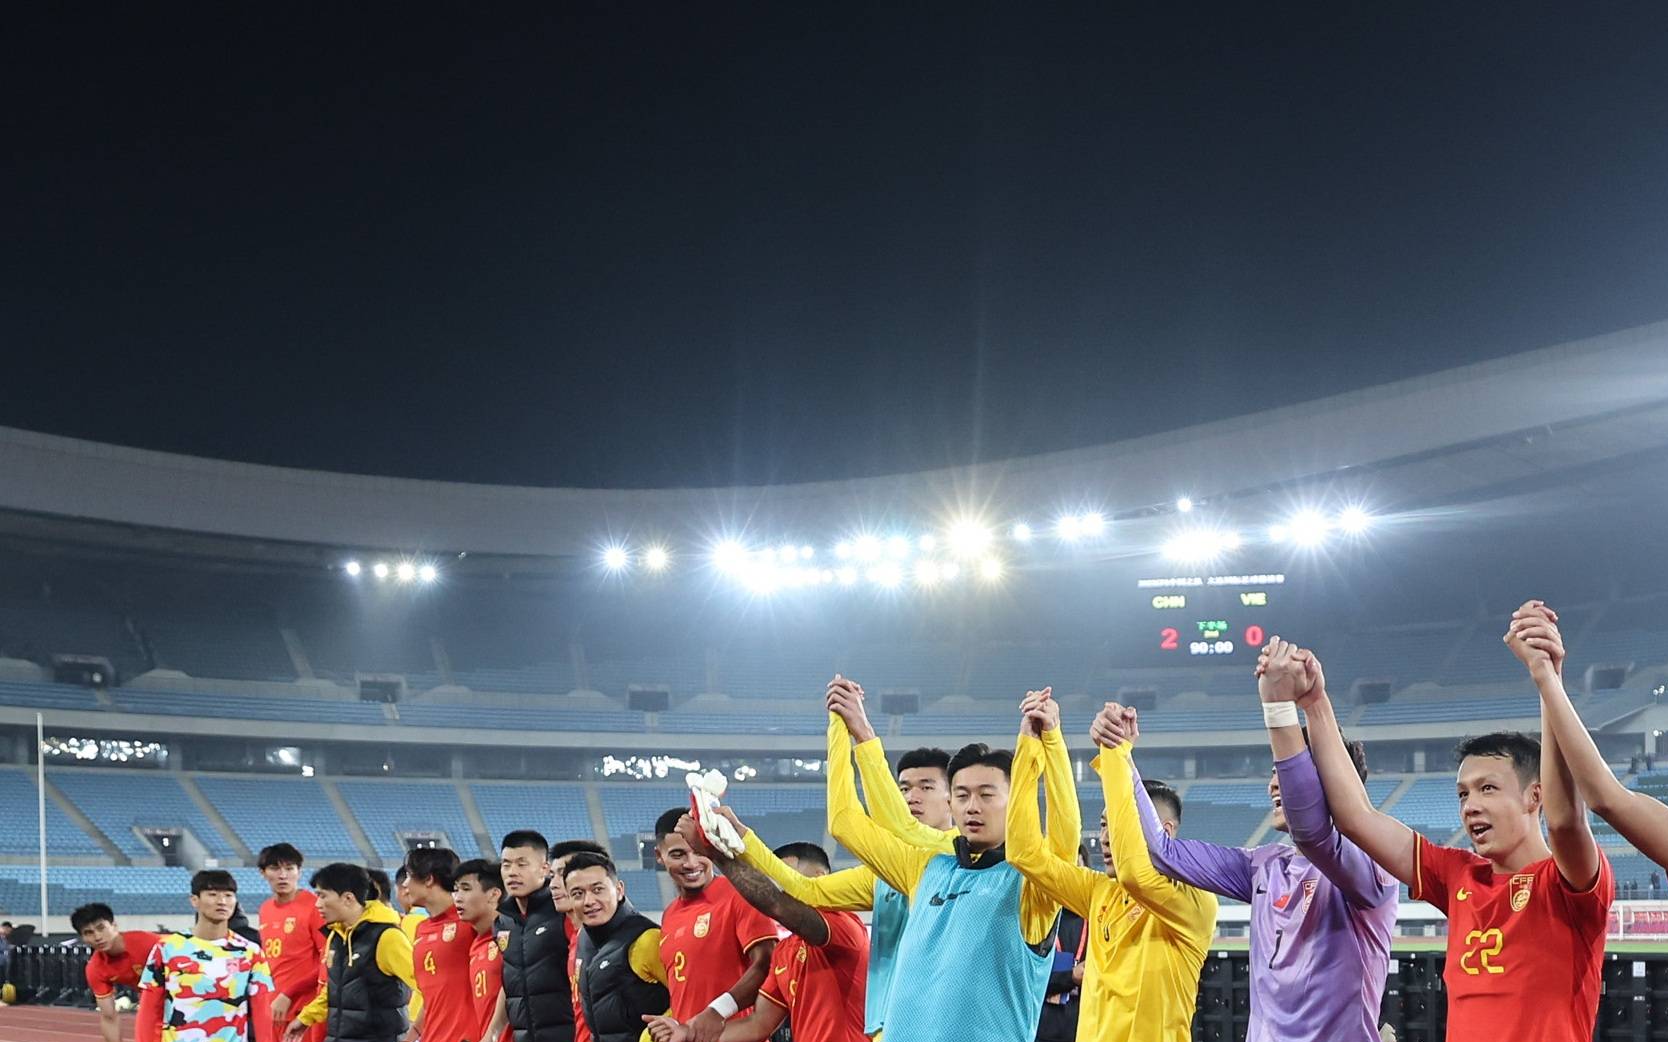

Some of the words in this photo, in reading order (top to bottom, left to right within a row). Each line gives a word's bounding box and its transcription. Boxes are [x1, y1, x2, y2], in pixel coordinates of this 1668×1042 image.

[1240, 592, 1267, 606] VIE
[1160, 628, 1179, 650] 2
[1245, 625, 1264, 647] 0
[264, 937, 282, 959] 28
[1459, 927, 1506, 975] 22
[423, 950, 436, 976] 4
[673, 950, 686, 982] 2
[475, 969, 487, 998] 21
